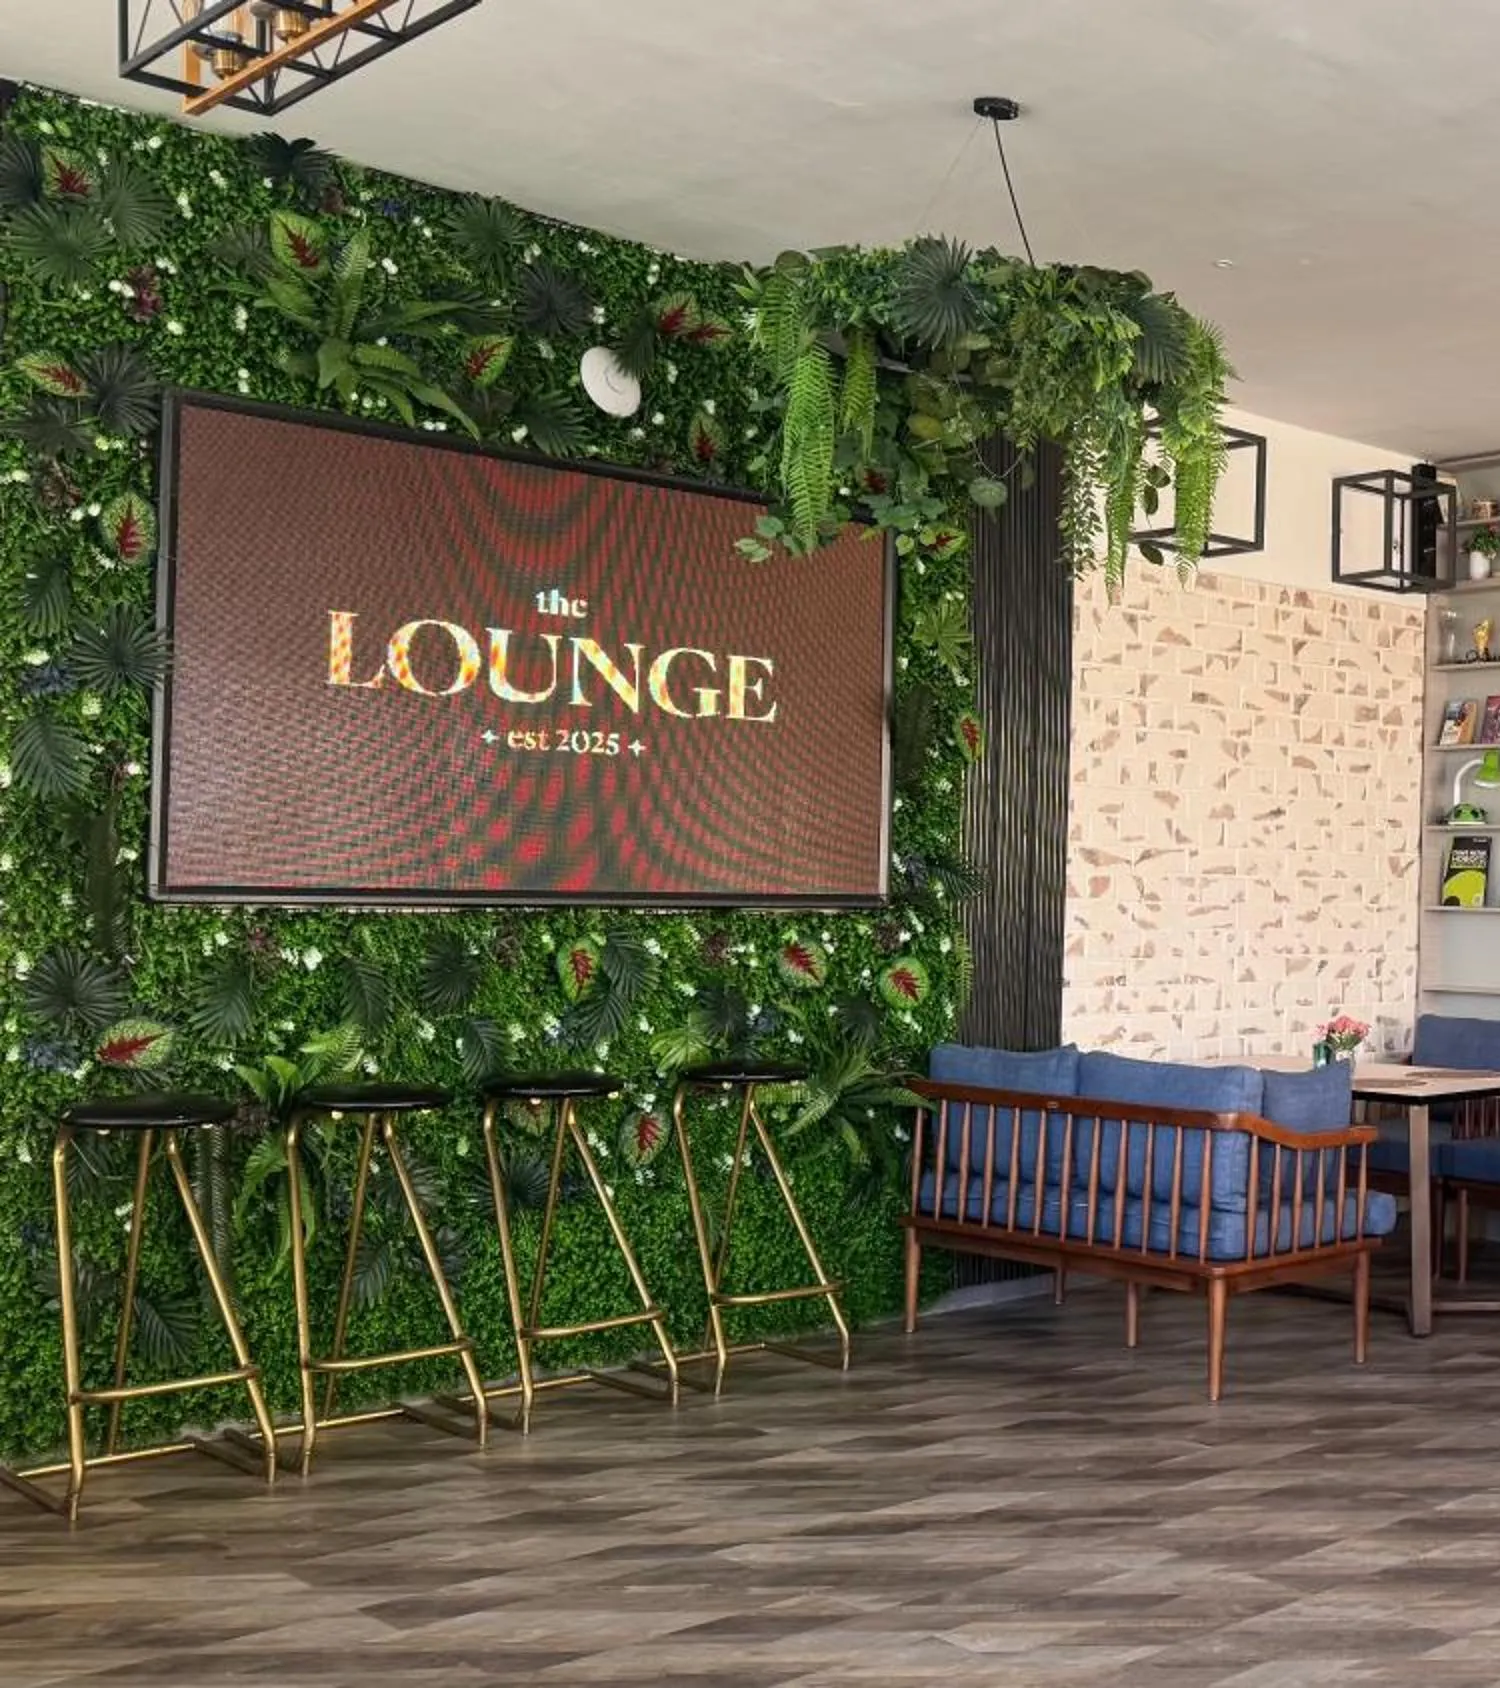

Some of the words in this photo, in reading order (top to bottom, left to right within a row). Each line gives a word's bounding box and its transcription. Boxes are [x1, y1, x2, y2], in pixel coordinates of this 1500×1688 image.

[535, 588, 588, 618] the
[327, 609, 778, 722] LOUNGE
[506, 728, 550, 751] est
[554, 729, 620, 755] 2025
